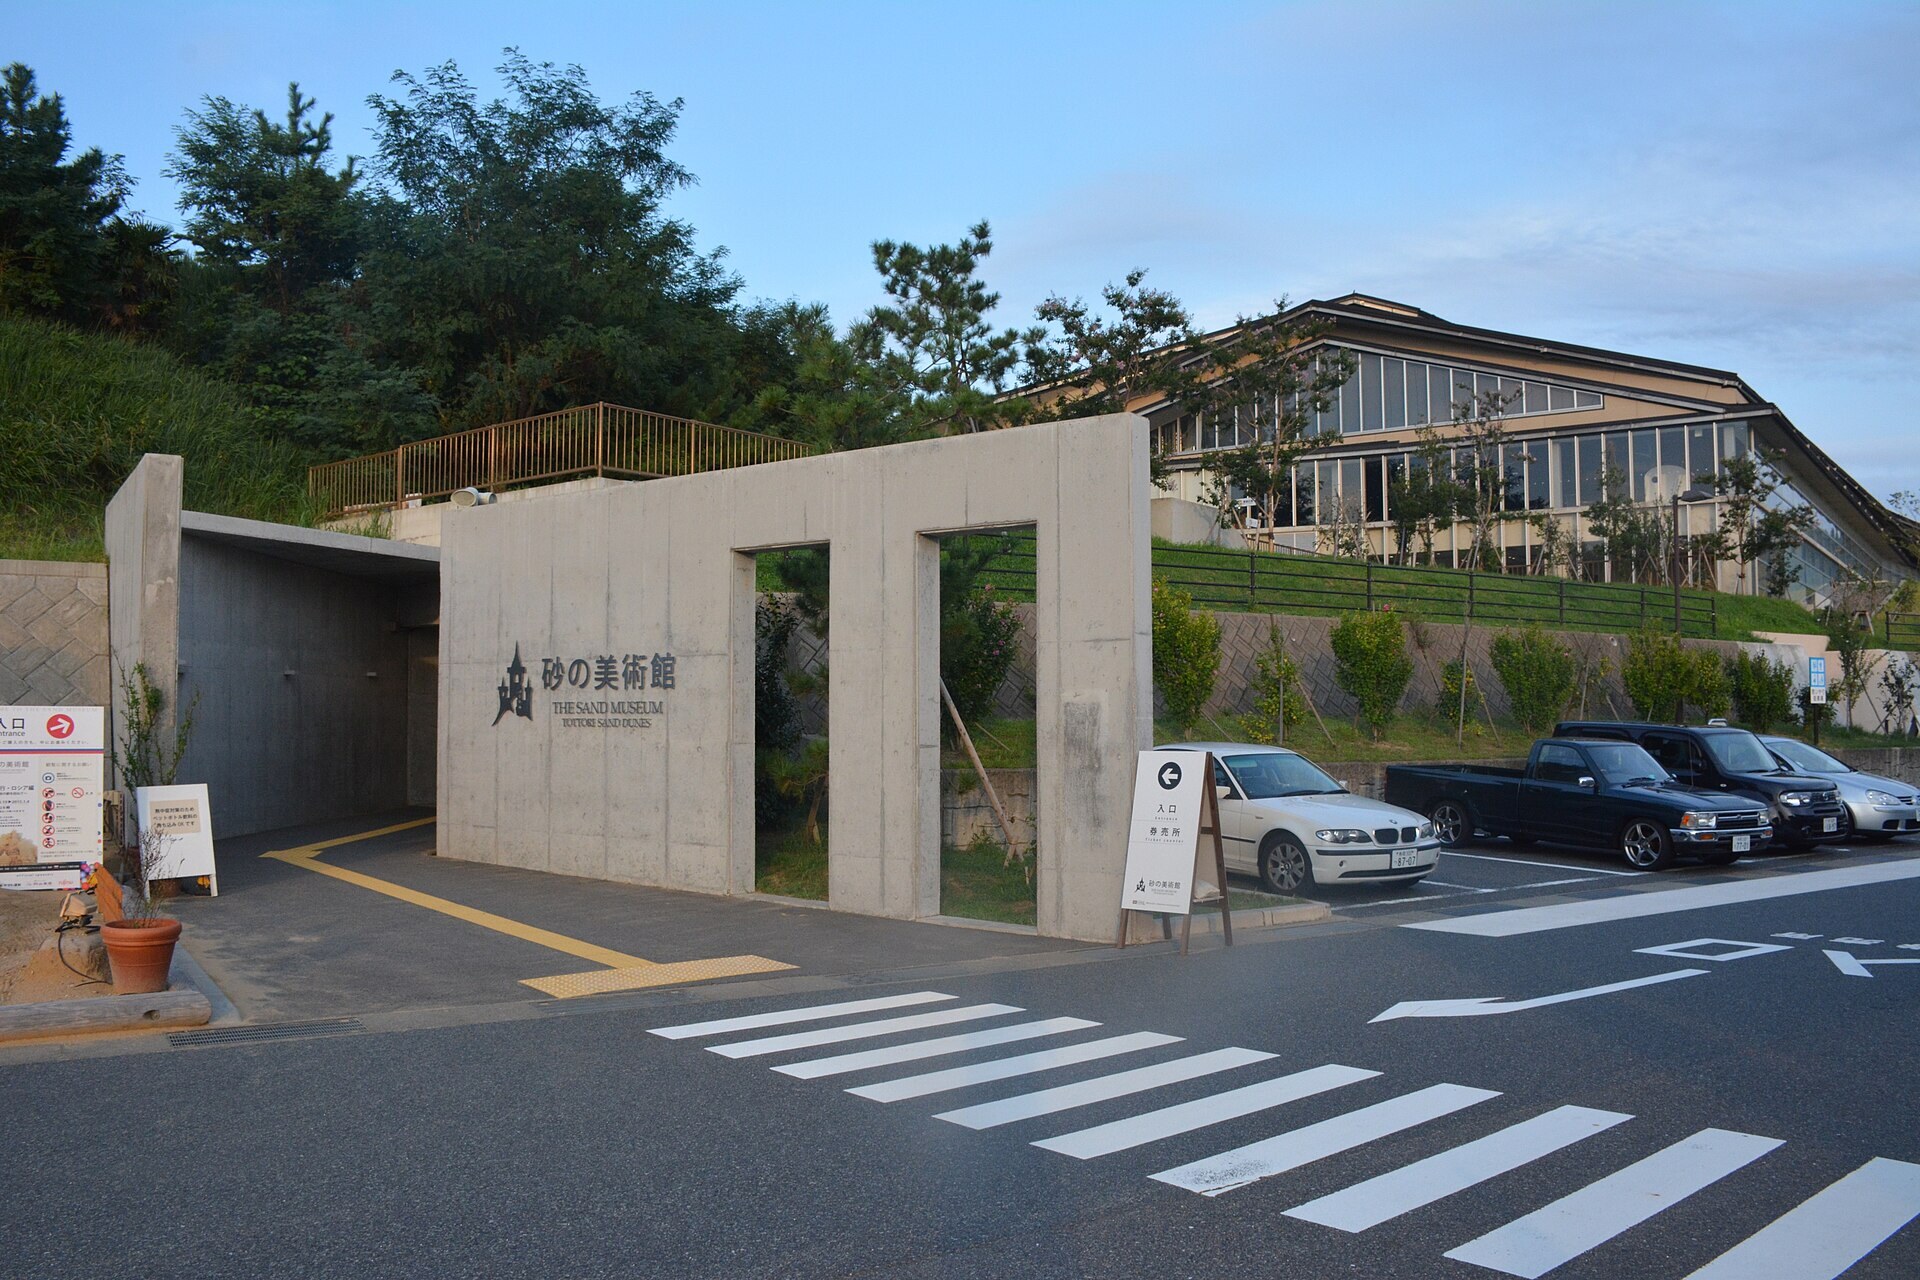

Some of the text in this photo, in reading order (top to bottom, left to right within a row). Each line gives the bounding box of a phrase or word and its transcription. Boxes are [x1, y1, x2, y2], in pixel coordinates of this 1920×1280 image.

[541, 652, 676, 691] 砂の美術館
[552, 701, 664, 716] THE SAND MUSEUM
[597, 718, 621, 728] SAND
[622, 718, 652, 728] DUNES
[1157, 804, 1177, 814] 入口
[1150, 827, 1181, 837] 券売所
[1397, 856, 1416, 867] 87-07
[1148, 879, 1181, 889] 砂の美術館
